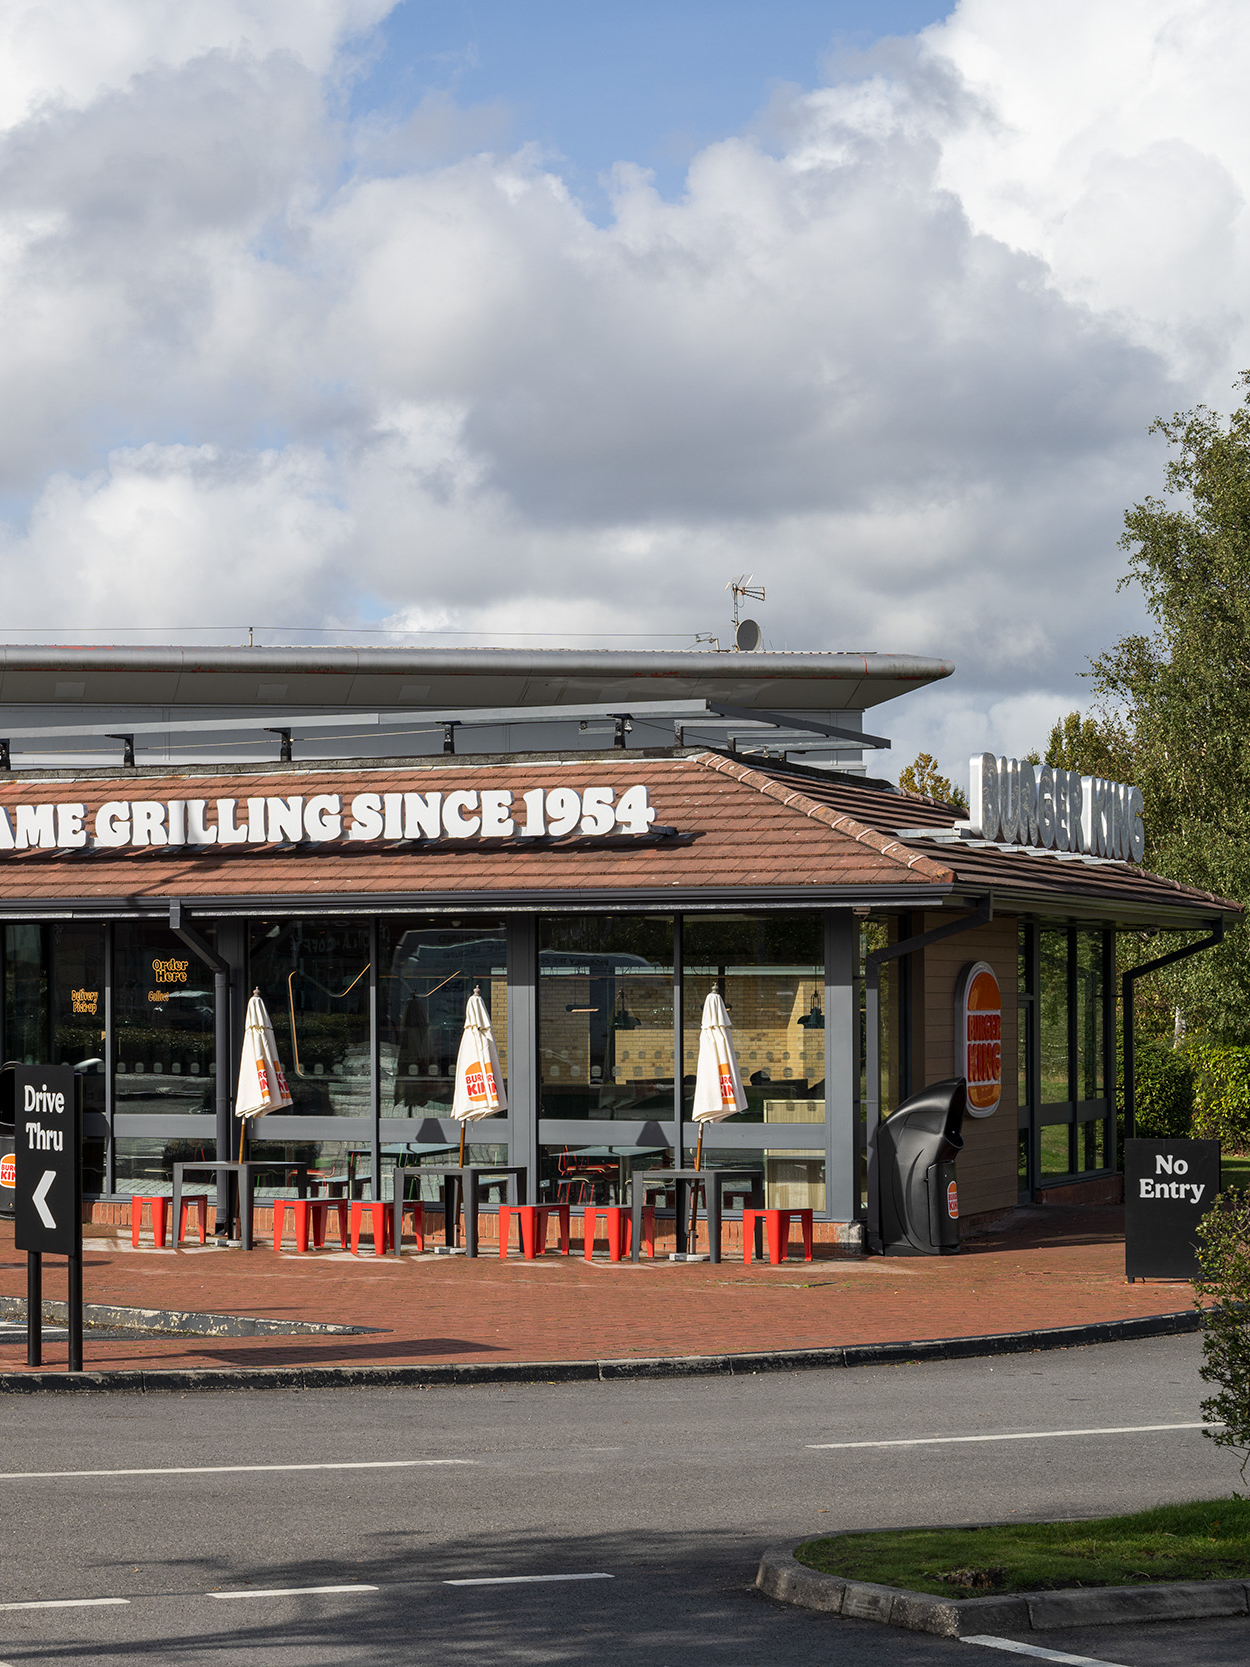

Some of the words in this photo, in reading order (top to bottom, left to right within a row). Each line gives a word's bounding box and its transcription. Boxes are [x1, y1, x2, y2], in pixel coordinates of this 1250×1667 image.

[95, 794, 343, 847] GRILLING
[351, 789, 517, 840] SINCE
[523, 785, 657, 837] 1954
[969, 752, 1083, 854] BURGER
[1081, 775, 1145, 863] KING
[152, 958, 189, 971] Order
[155, 970, 188, 983] Here
[71, 988, 98, 1003] Delivery
[967, 1014, 1001, 1041] BURGER
[967, 1042, 1002, 1082] KING
[24, 1084, 65, 1113] Drive
[25, 1122, 63, 1151] Thru
[1155, 1155, 1189, 1175] No
[1139, 1178, 1205, 1204] Entry
